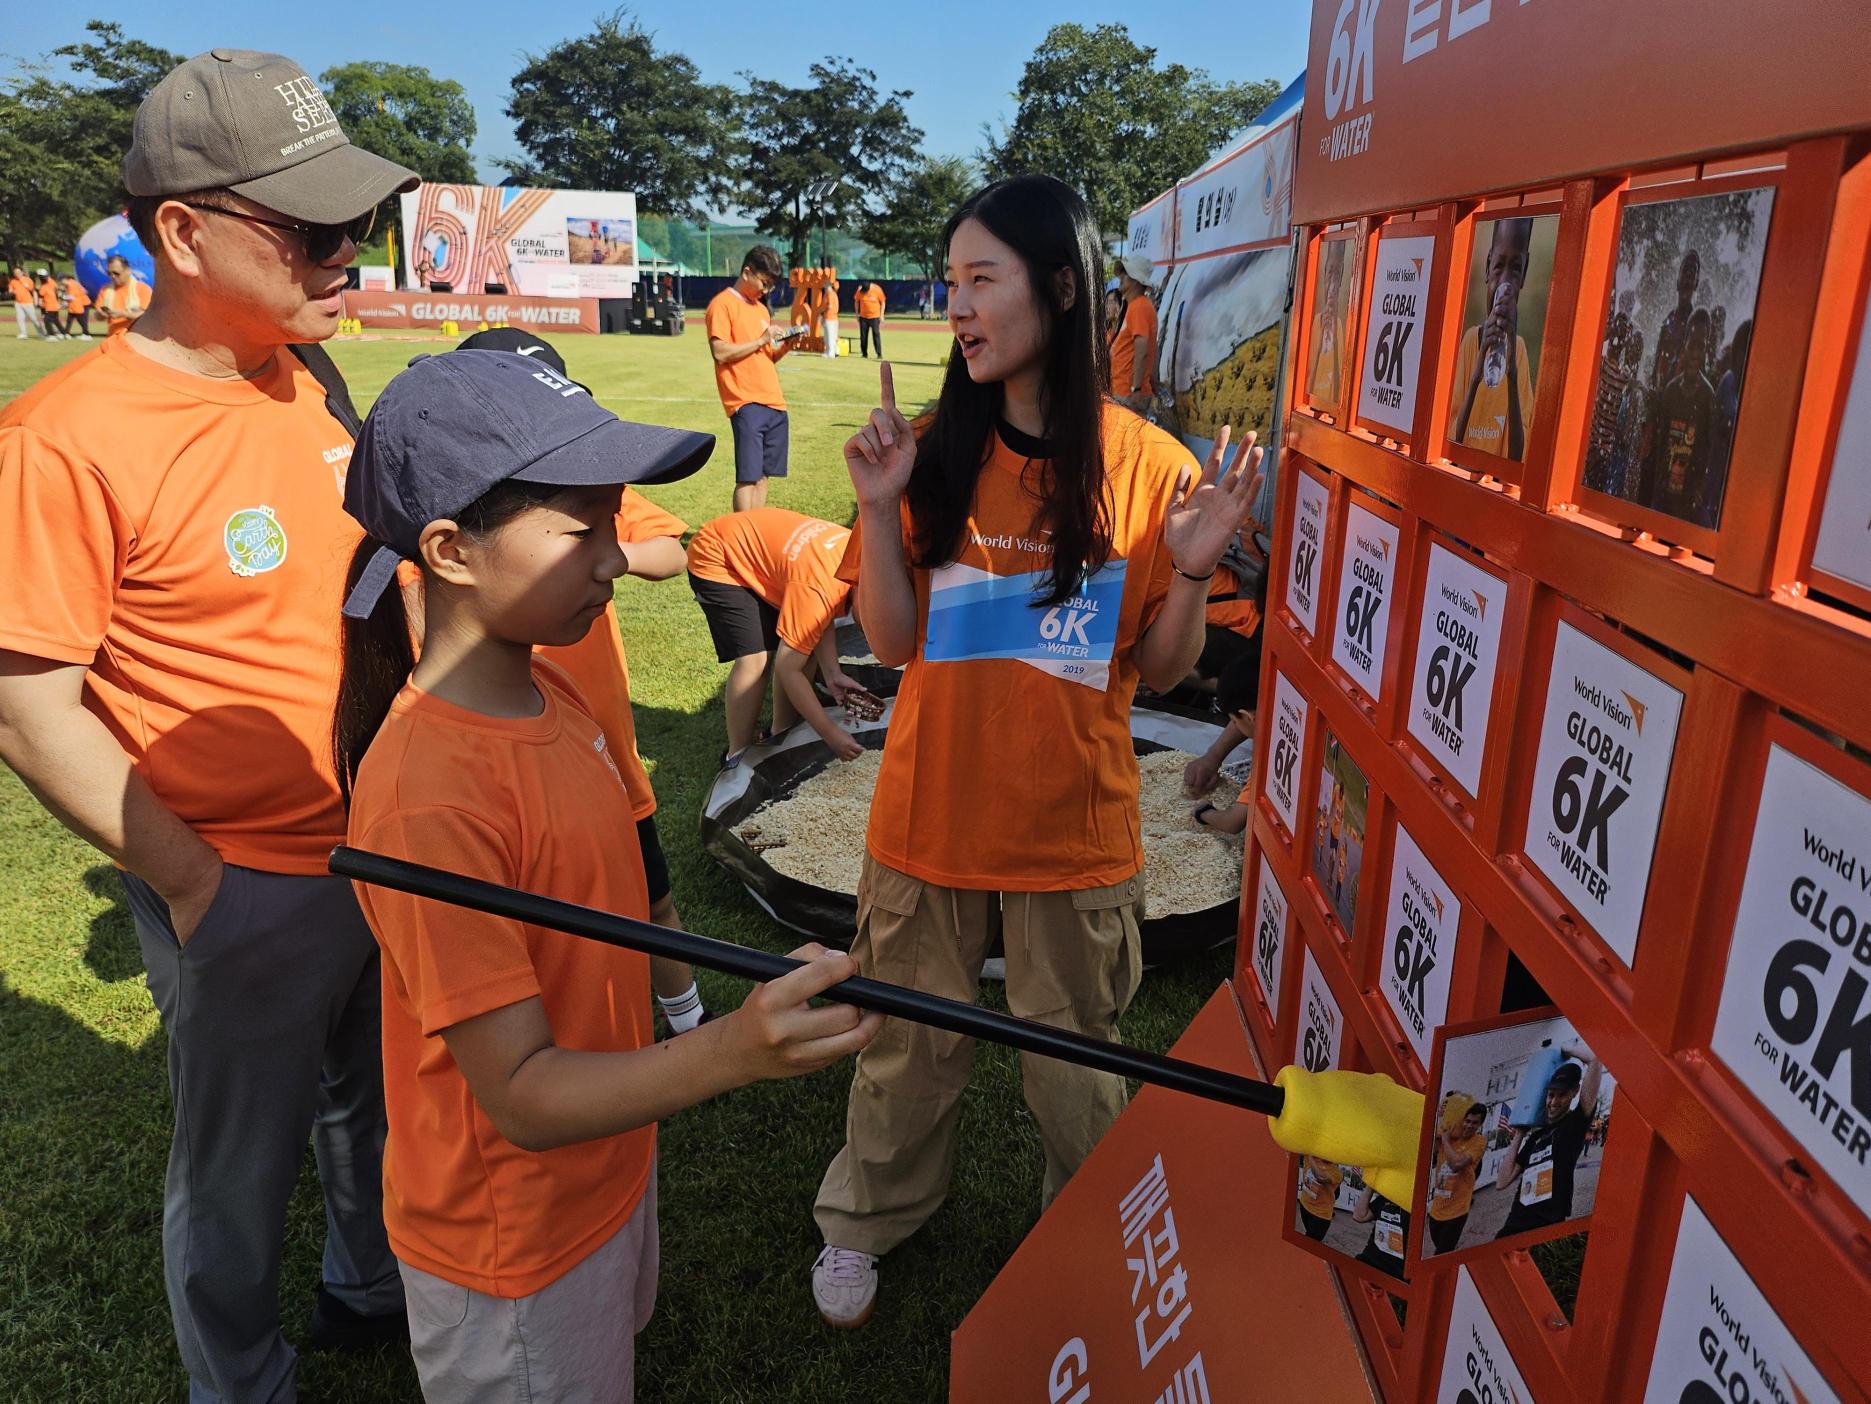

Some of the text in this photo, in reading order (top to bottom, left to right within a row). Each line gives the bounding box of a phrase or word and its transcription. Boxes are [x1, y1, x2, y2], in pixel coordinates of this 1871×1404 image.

[281, 141, 304, 156] BREAK
[1319, 113, 1372, 162] FOR WATER
[511, 239, 546, 248] GLOBAL
[535, 249, 565, 257] WATER
[1387, 268, 1415, 282] World Vision
[411, 302, 482, 321] GLOBAL
[485, 304, 509, 321] 6K
[521, 306, 580, 324] WATER
[1382, 293, 1416, 317] GLOBAL
[1373, 321, 1414, 387] 6K
[1377, 387, 1402, 409] WATER
[970, 534, 1012, 549] World
[1300, 516, 1318, 546] GLOBAL
[1357, 534, 1383, 561] World Vision
[1294, 540, 1317, 597] 6K
[1353, 557, 1384, 595] GLOBAL
[1060, 597, 1099, 611] OBAL
[1297, 588, 1311, 614] WATER
[1346, 585, 1382, 654] 6K
[1441, 583, 1478, 619] World Vision
[1040, 607, 1097, 646] 6K
[1047, 642, 1089, 658] WATER
[1436, 610, 1478, 661] GLOBAL
[1063, 664, 1085, 674] 2019
[1349, 641, 1372, 675] WATER
[1426, 645, 1477, 733] 6K
[1574, 675, 1631, 730] World Vision
[1279, 716, 1299, 752] GLOBAL
[1422, 707, 1462, 757] FOR WATER
[1567, 710, 1633, 786] GLOBAL
[1274, 738, 1298, 798] 6K
[1276, 782, 1292, 813] WATER
[1552, 755, 1630, 877] 6K
[1547, 831, 1608, 906] FOR WATER
[1803, 827, 1856, 883] World
[1406, 866, 1436, 918] World Vision
[1402, 891, 1438, 957] GLOBAL
[1790, 875, 1871, 967] GLOB
[1259, 920, 1278, 982] 6K
[1394, 925, 1436, 1019] 6K
[1308, 1000, 1331, 1059] GLOBAL
[1398, 986, 1424, 1040] WATER
[1763, 939, 1871, 1121] 6K
[1303, 1026, 1330, 1073] 6K
[1753, 1031, 1871, 1167] FOR WATER
[1119, 1152, 1193, 1370] 깨끗한
[1472, 1323, 1493, 1373] World
[1699, 1326, 1749, 1404] GLO
[1710, 1284, 1790, 1404] World Visio
[1467, 1352, 1493, 1404] GLO
